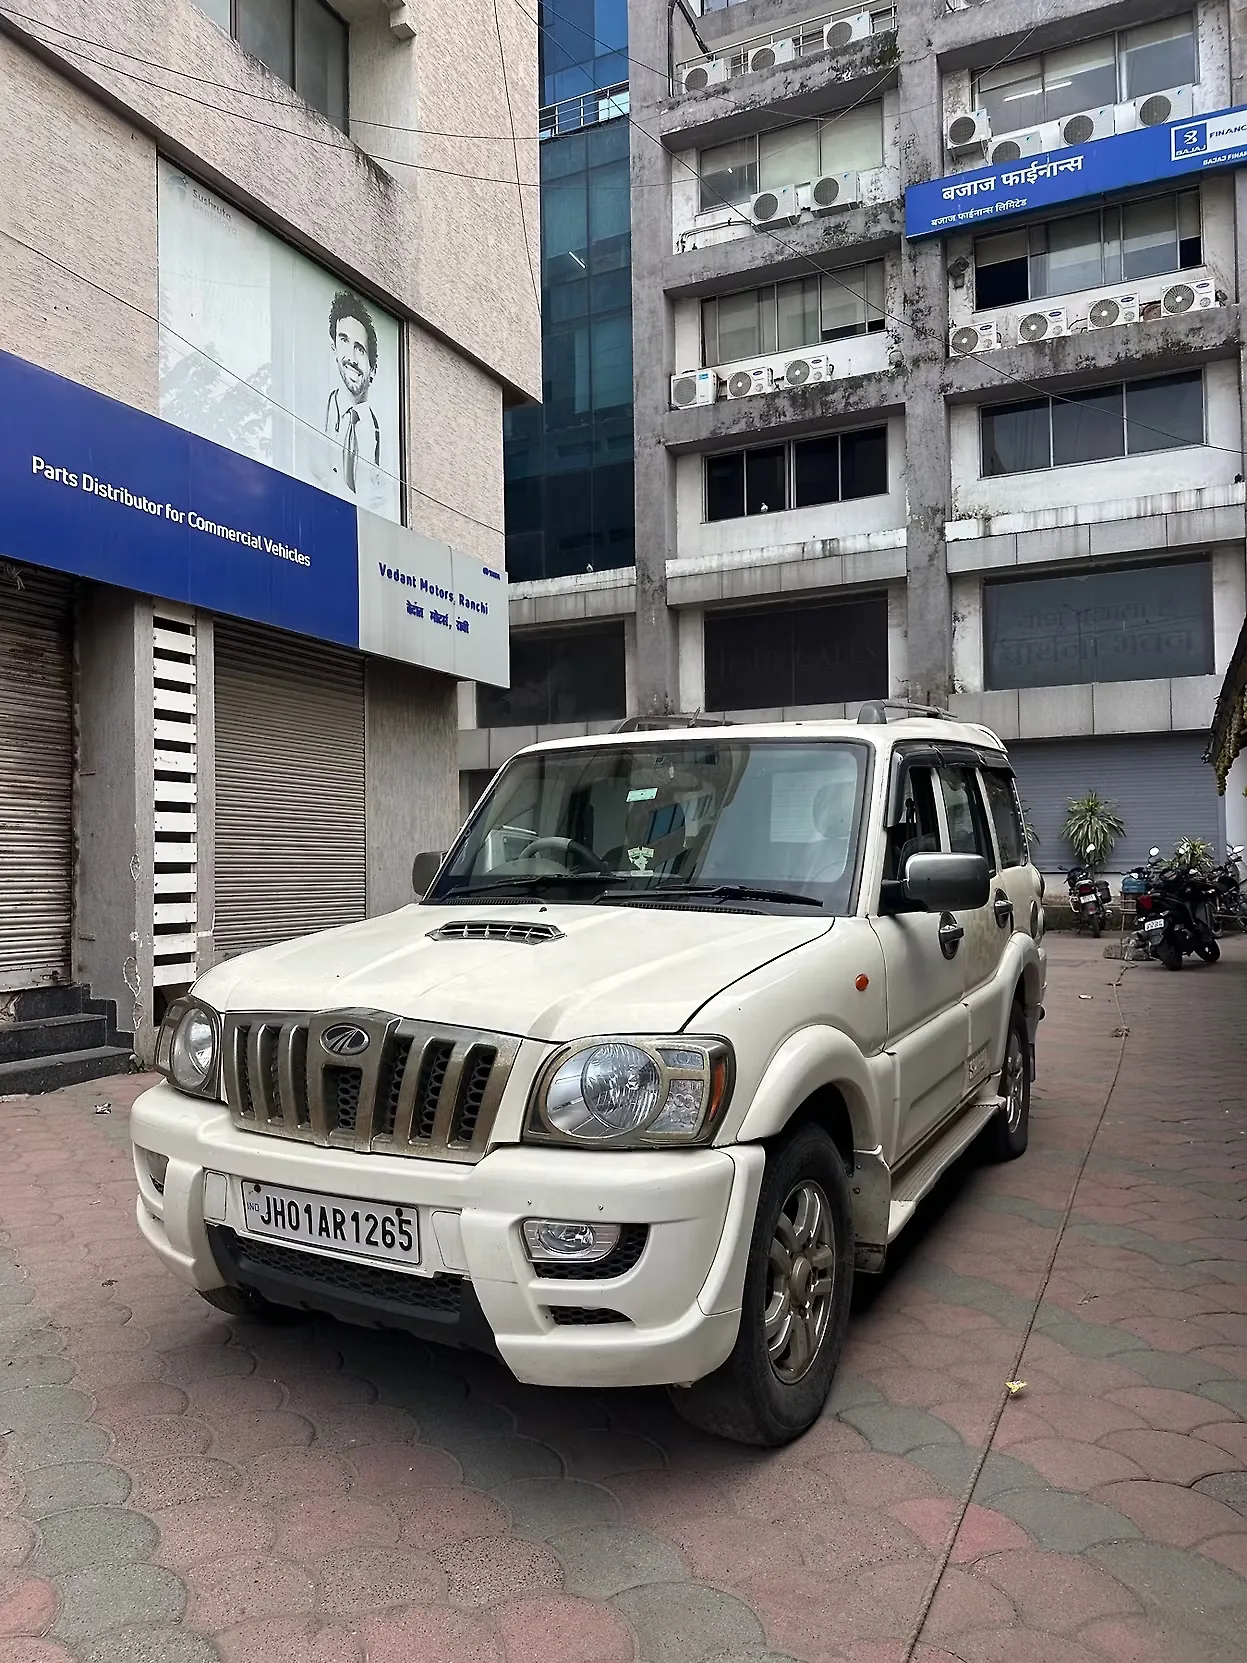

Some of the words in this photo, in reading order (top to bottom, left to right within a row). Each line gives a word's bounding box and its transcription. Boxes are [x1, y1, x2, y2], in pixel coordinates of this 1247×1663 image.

[942, 176, 996, 201] बजाज
[1000, 155, 1084, 185] फाईनान्स
[931, 214, 956, 227] बजाज
[31, 455, 79, 488] Parts
[82, 474, 163, 517] Distributor
[165, 502, 185, 524] for
[187, 511, 263, 550] Commercial
[264, 538, 311, 567] Vehicles
[378, 562, 417, 588] Vedant
[459, 593, 489, 615] Ranchi
[260, 1194, 414, 1252] JH01AR1265
